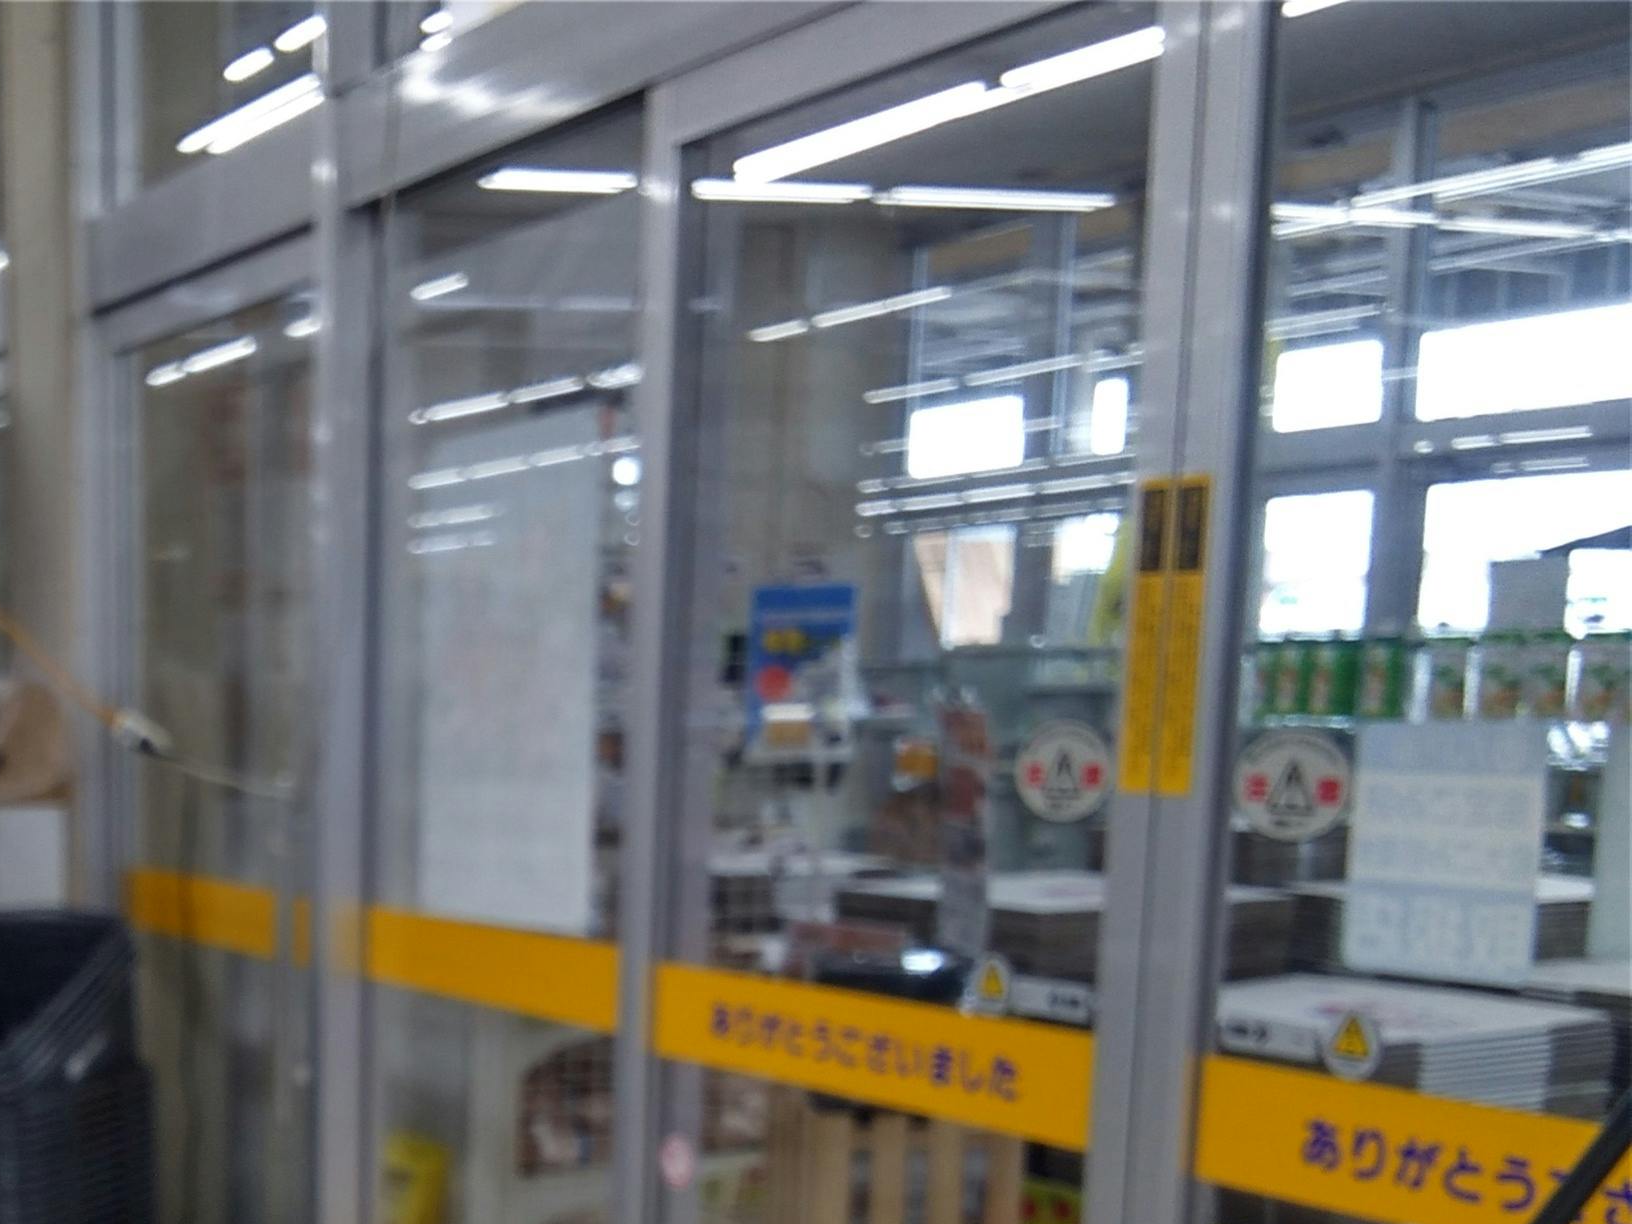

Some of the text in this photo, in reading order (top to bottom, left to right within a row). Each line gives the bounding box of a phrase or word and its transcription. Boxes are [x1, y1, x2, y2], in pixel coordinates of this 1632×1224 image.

[711, 1001, 1019, 1102] ありがとうございました
